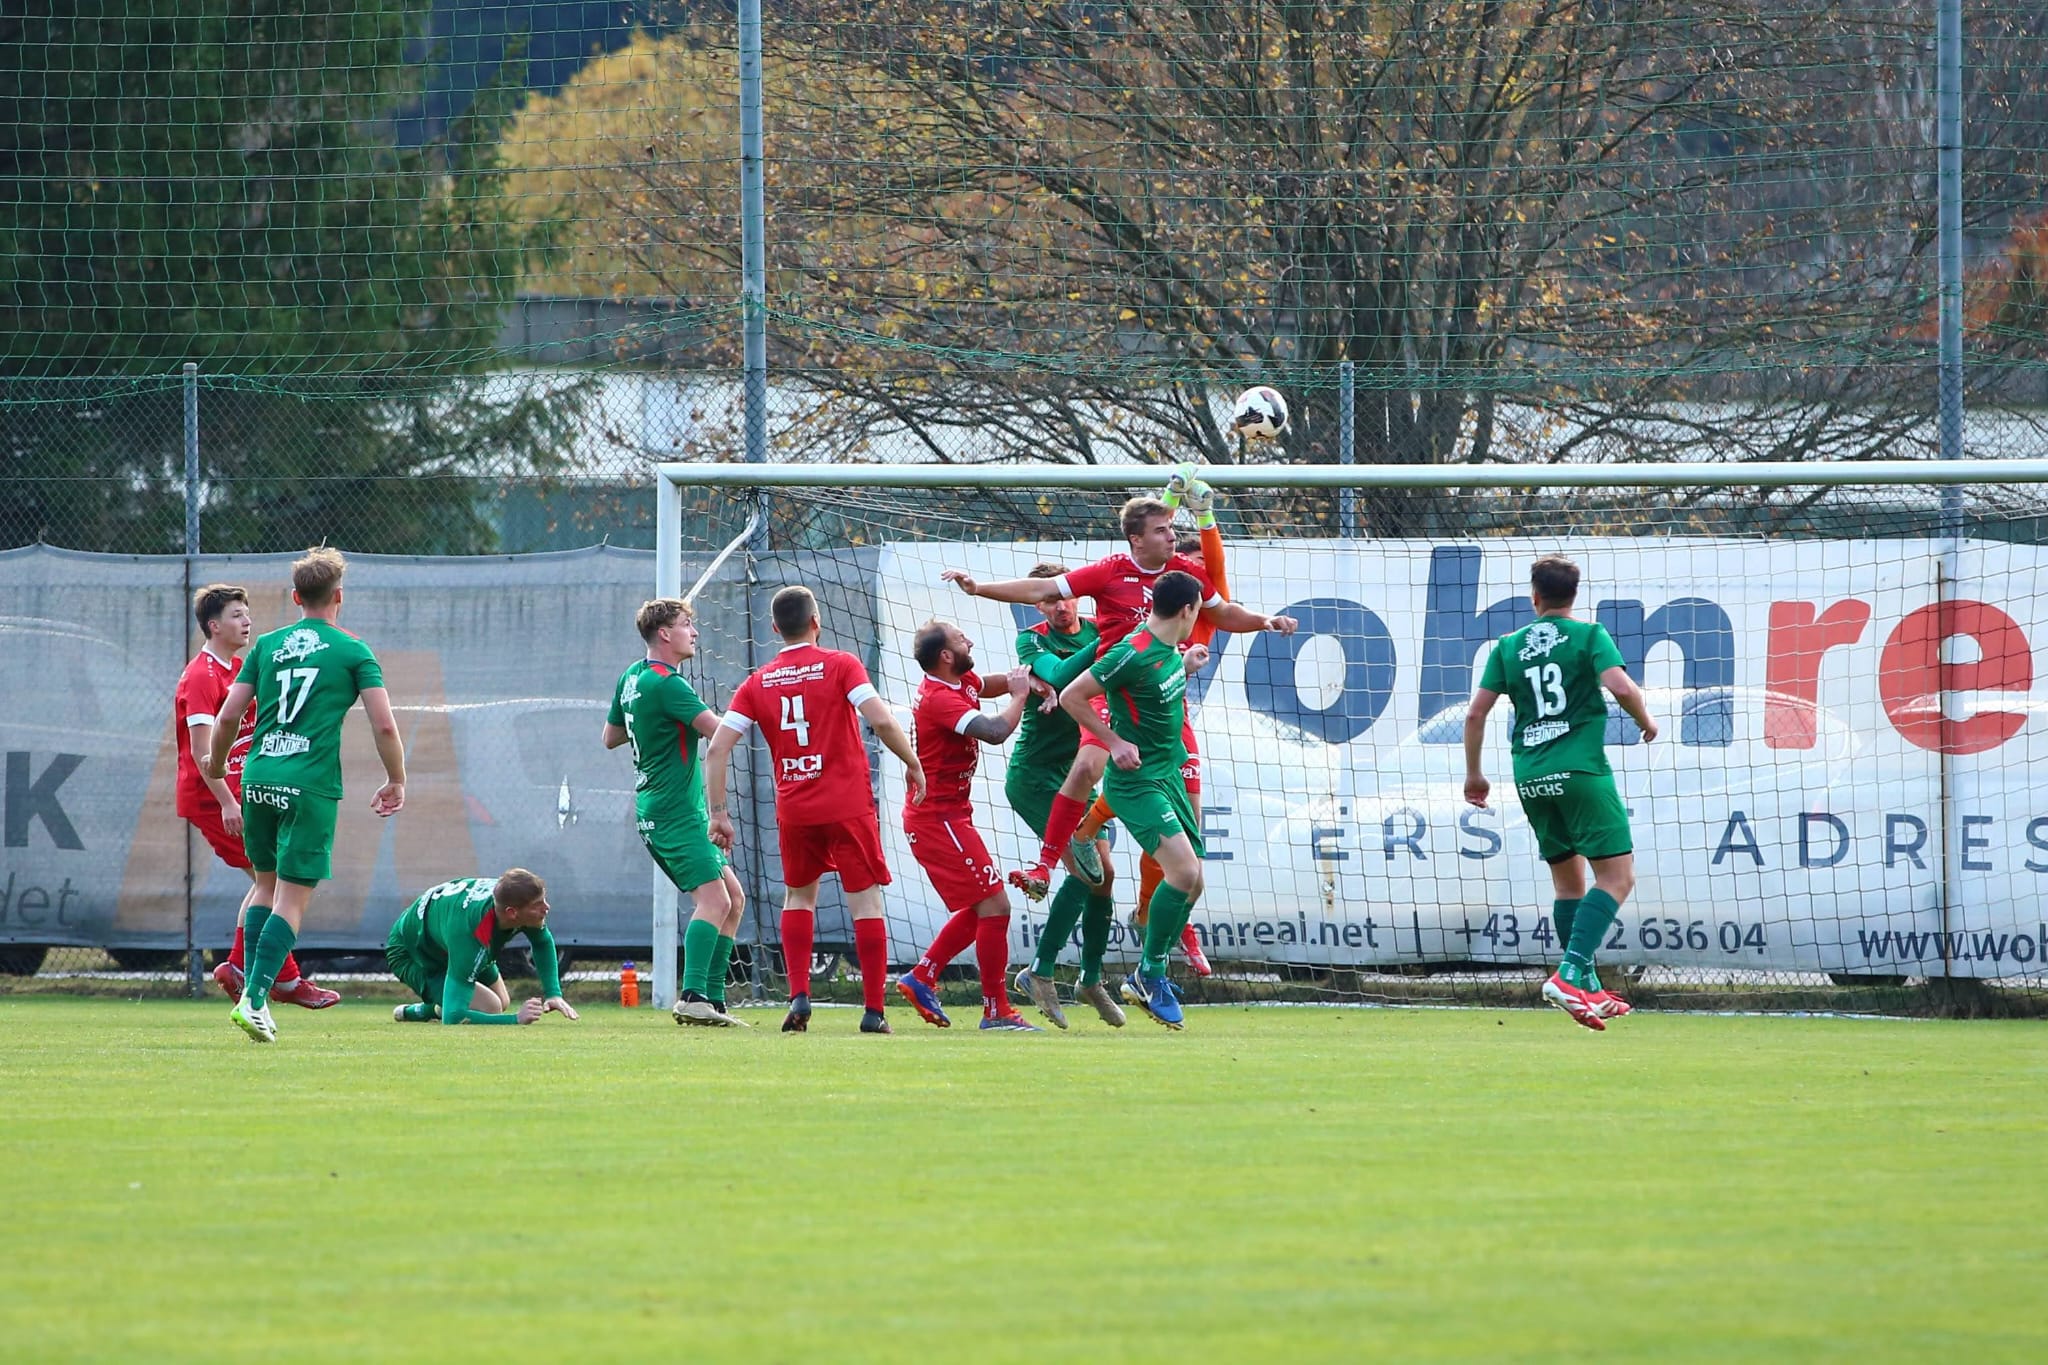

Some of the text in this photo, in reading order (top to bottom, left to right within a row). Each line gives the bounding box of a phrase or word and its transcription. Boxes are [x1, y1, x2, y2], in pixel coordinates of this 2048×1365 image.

[275, 667, 320, 724] 17
[1524, 662, 1567, 719] 13
[780, 694, 810, 747] 4
[781, 754, 822, 774] PCI
[4, 751, 88, 851] K
[245, 789, 290, 811] FUCHS
[1519, 782, 1564, 800] FUCHS
[1312, 806, 1635, 863] ERS
[1532, 917, 1627, 950] 42
[1640, 917, 1708, 952] 636
[1719, 920, 1767, 954] 04
